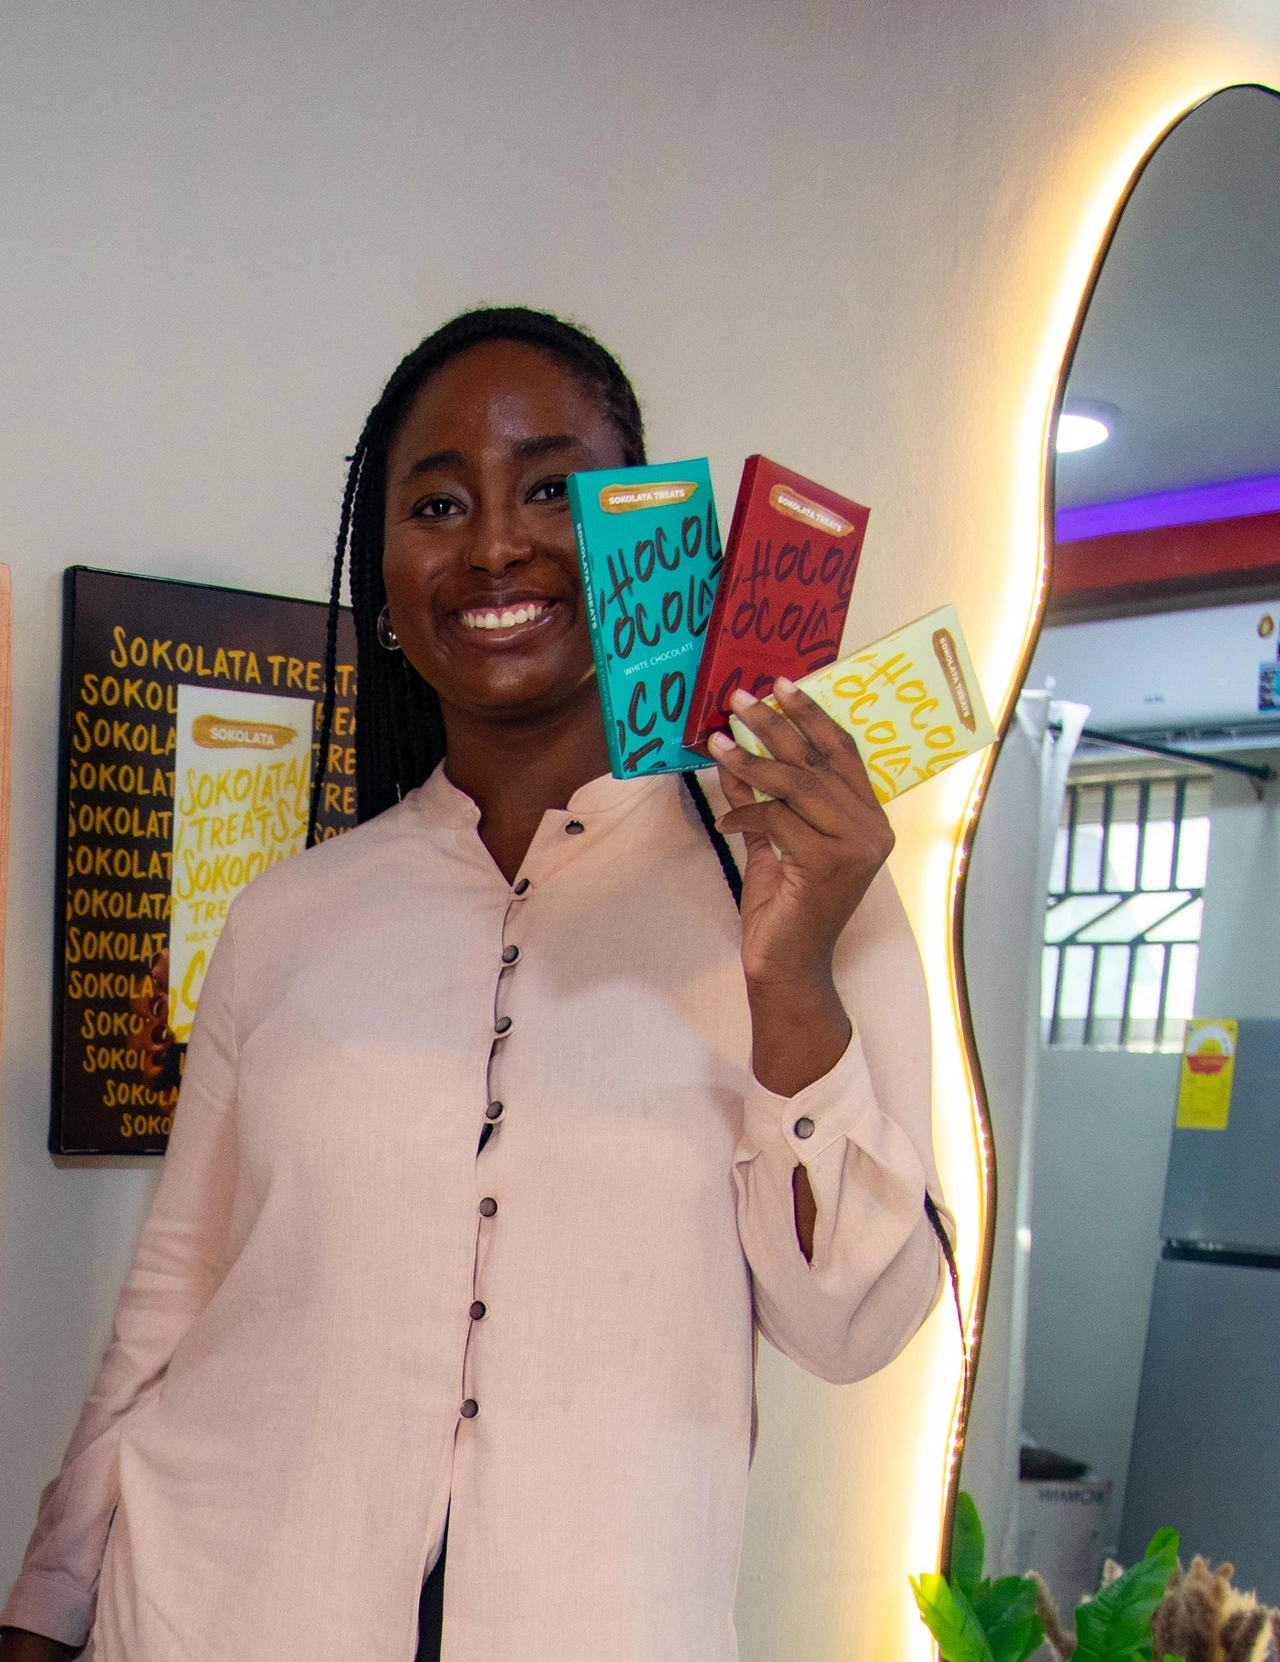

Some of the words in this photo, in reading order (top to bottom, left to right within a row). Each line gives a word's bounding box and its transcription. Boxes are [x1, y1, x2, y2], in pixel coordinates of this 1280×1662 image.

[609, 493, 652, 505] SOKOLATA
[654, 489, 685, 500] TREATS
[778, 495, 815, 520] SOKOLATA
[815, 511, 842, 533] TREATS
[576, 522, 590, 583] SOKOLATA
[586, 584, 598, 630] TREATS
[111, 625, 262, 685] SOKOLATA
[267, 655, 357, 698] TRET
[623, 660, 650, 677] WHITE
[650, 641, 696, 666] CHOCOLATE
[939, 637, 960, 681] SOKOLATA
[954, 681, 970, 718] TREATS
[210, 726, 275, 746] SOKOLATA
